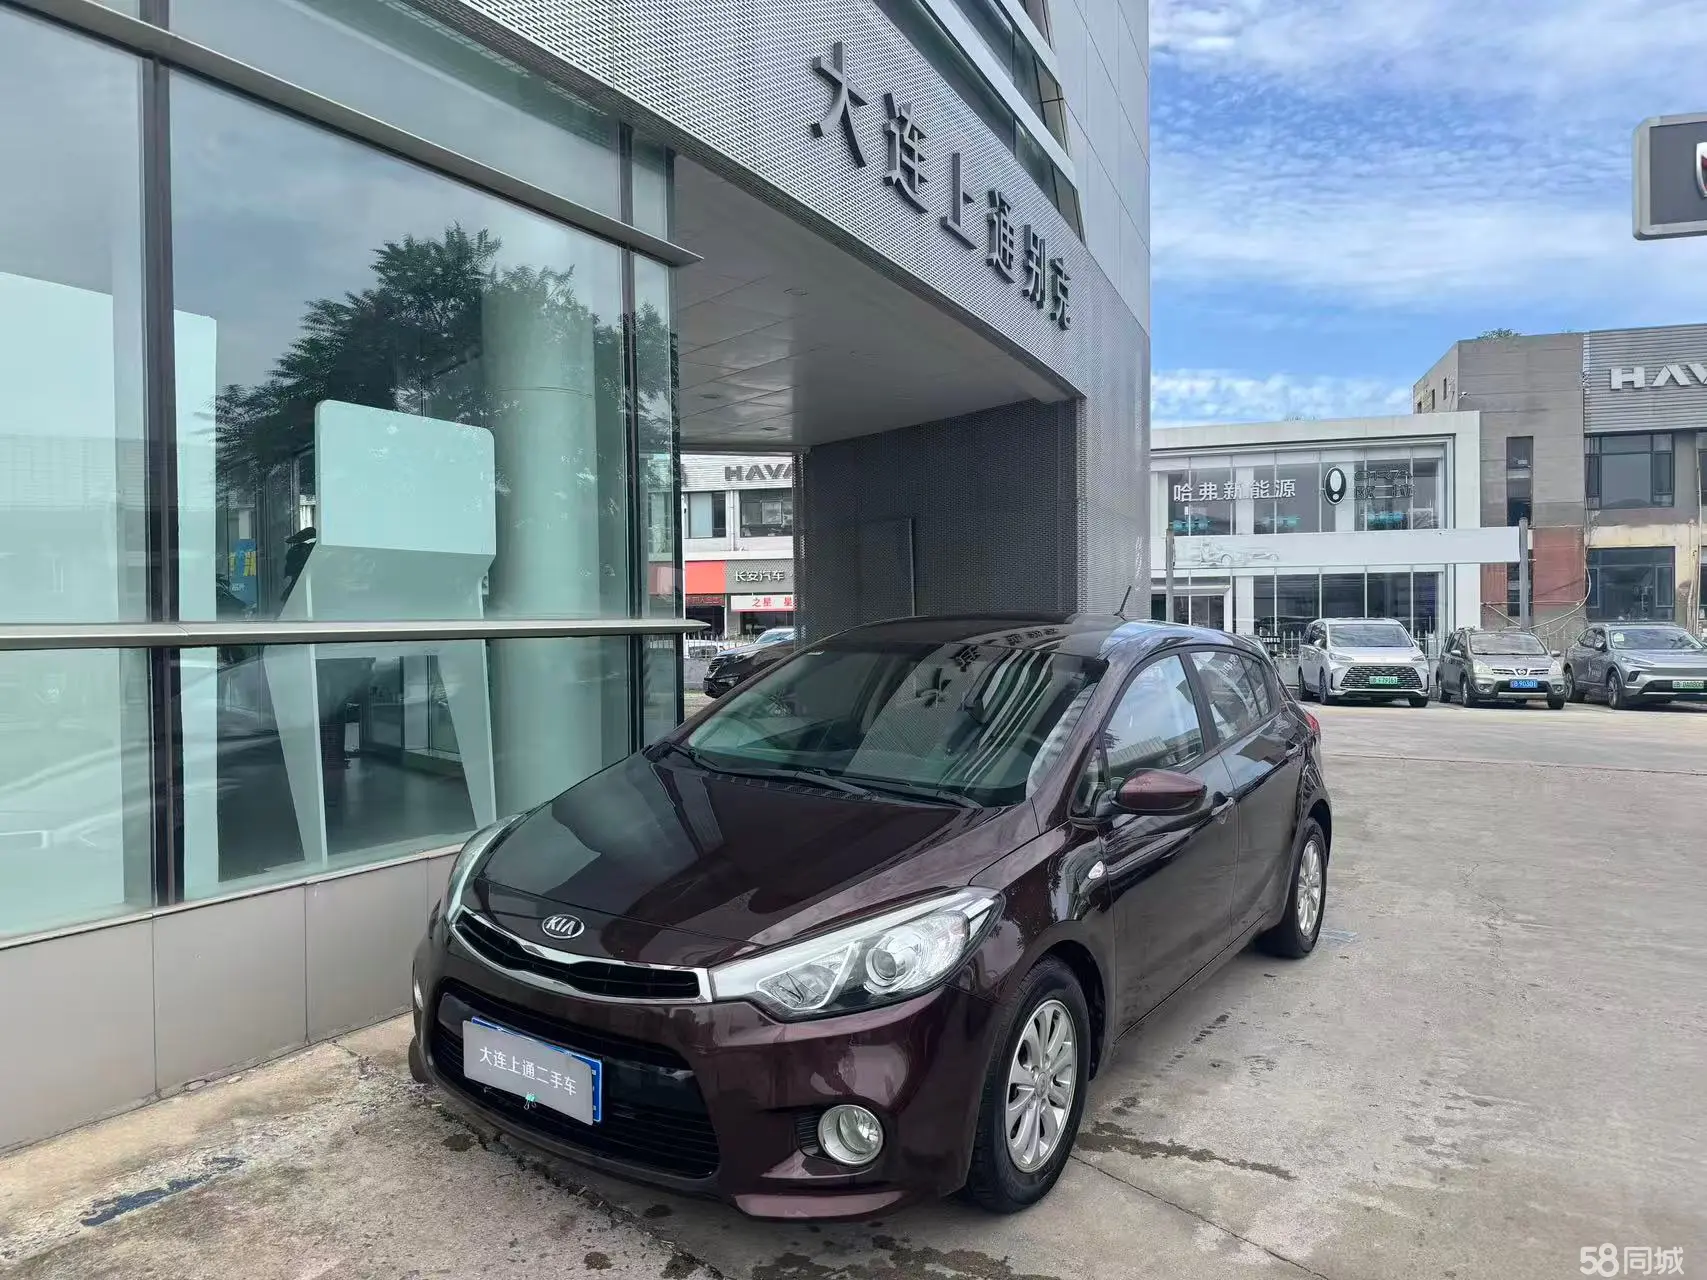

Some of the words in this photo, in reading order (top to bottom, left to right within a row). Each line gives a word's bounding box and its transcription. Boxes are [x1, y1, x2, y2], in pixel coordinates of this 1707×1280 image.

[811, 41, 1072, 330] 大连上通别克
[1173, 478, 1297, 502] 哈弗新能源
[735, 570, 785, 582] 长安汽车
[545, 915, 576, 936] KIA
[479, 1046, 577, 1096] 大连上通二手车
